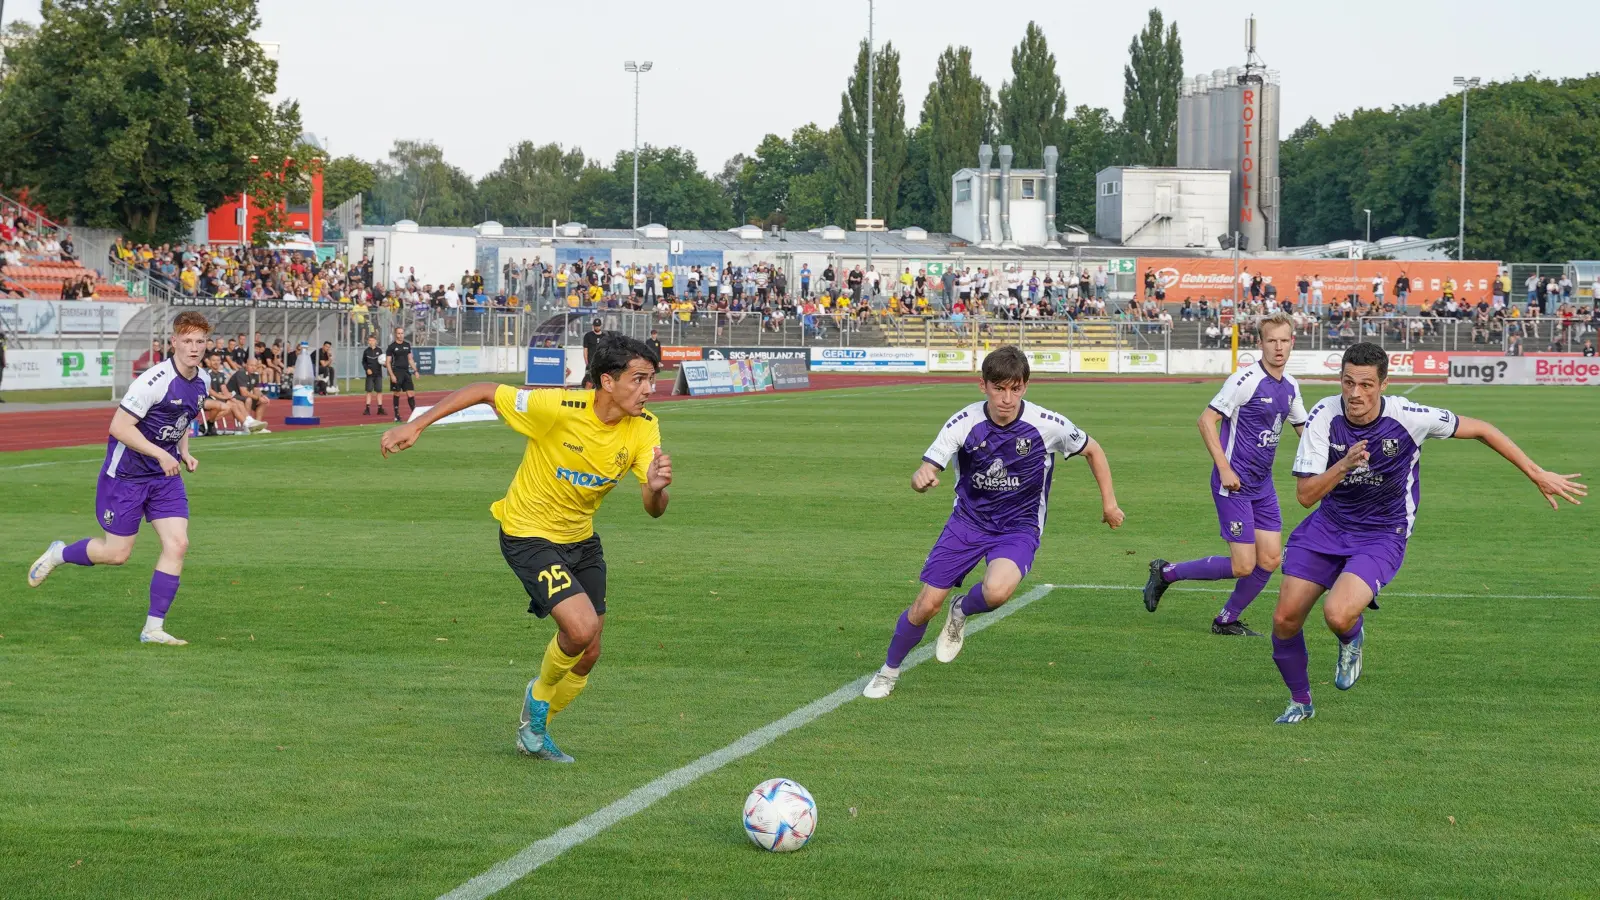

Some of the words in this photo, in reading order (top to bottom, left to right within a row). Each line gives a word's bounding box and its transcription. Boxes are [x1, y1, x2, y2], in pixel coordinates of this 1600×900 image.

[1240, 88, 1255, 222] ROTTOLIN
[674, 241, 680, 253] J
[1351, 247, 1360, 258] K
[1181, 273, 1235, 284] Gebrüder
[823, 350, 867, 359] GERLITZ
[869, 350, 915, 359] elektro-gmbh
[563, 442, 584, 453] capelli
[537, 564, 572, 599] 25
